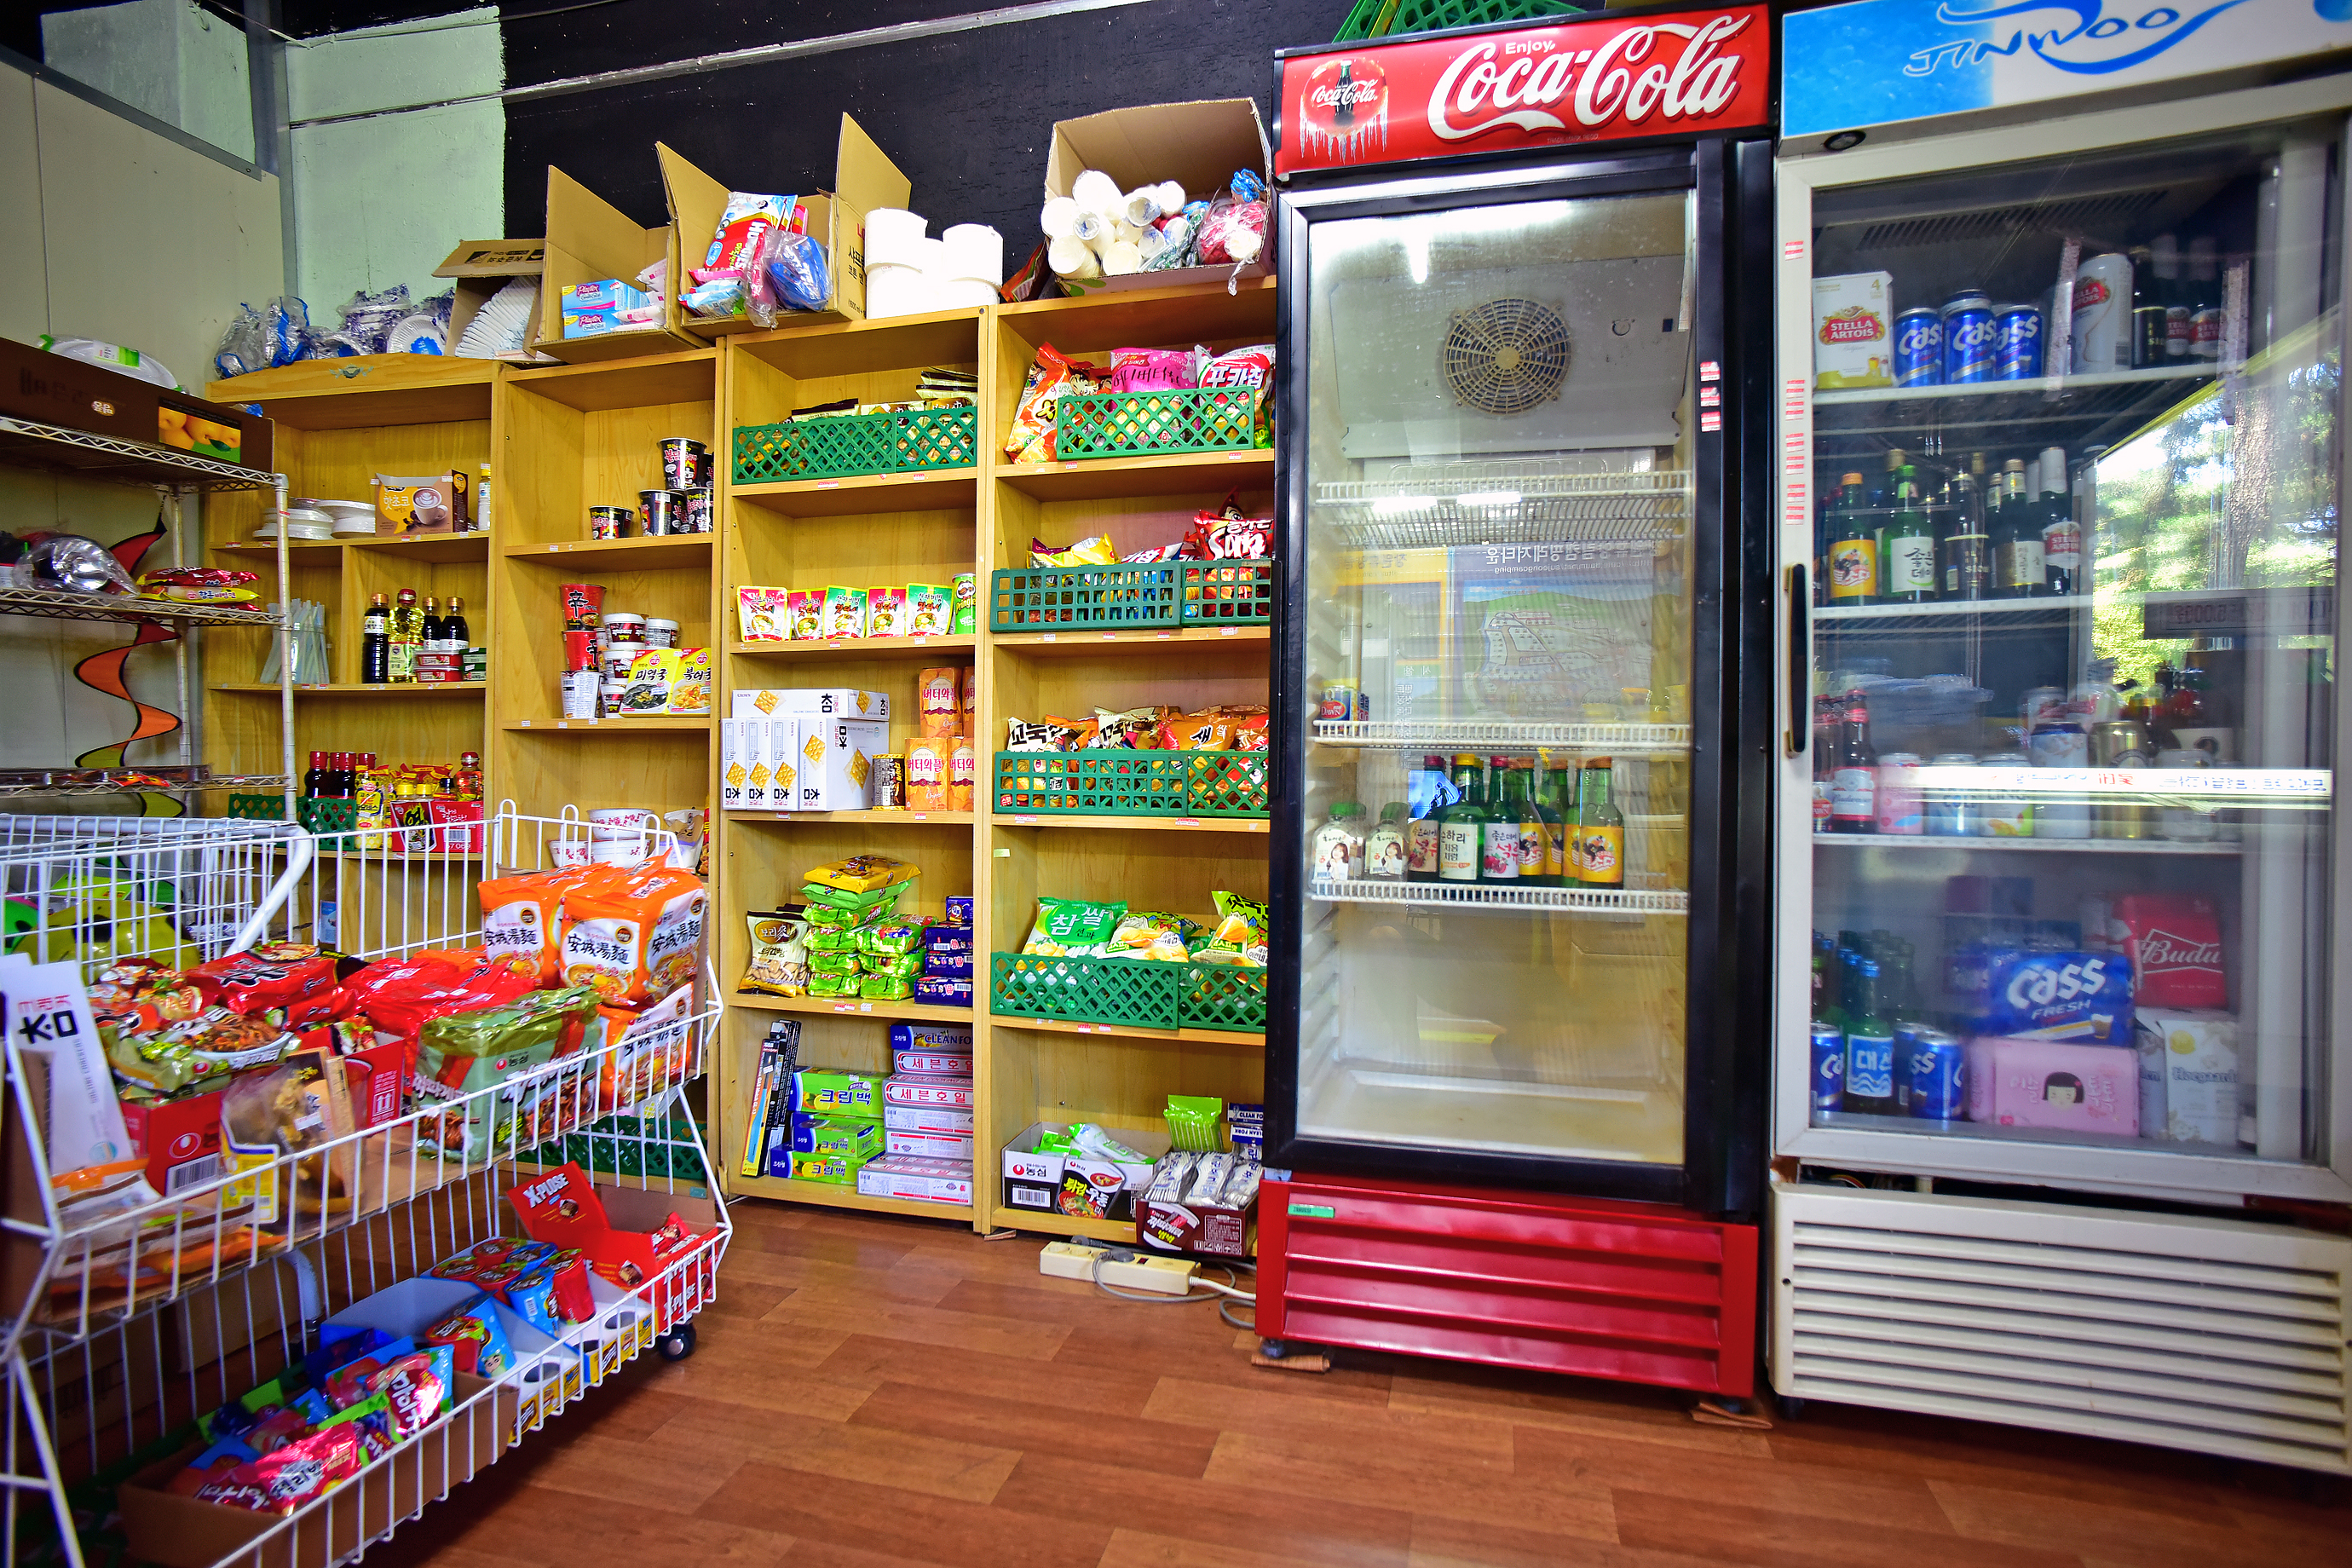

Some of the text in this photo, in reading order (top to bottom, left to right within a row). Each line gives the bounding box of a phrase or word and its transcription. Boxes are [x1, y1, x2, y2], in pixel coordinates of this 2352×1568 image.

[1505, 39, 1556, 55] Enjoy
[1427, 14, 1752, 140] Coca-Cola
[1311, 78, 1378, 107] Coca-Cola
[1830, 320, 1873, 331] STELLA
[1830, 328, 1874, 339] ARTOIS
[1114, 367, 1180, 388] 허니버터칩
[383, 495, 410, 511] 핫초코
[568, 590, 589, 619] 辛
[635, 668, 667, 682] 미역국
[907, 758, 943, 773] 버터와플
[949, 758, 975, 772] 버터와
[1050, 907, 1111, 936] 참쌀
[2007, 959, 2107, 1009] Cass
[2032, 1000, 2091, 1020] FRESH
[925, 1034, 957, 1045] CLEAN
[820, 1088, 873, 1106] 크린백
[900, 1088, 967, 1104] 세븐호일
[821, 1139, 849, 1150] 크린백
[811, 1163, 846, 1178] 크린백
[1026, 1166, 1046, 1178] 농심
